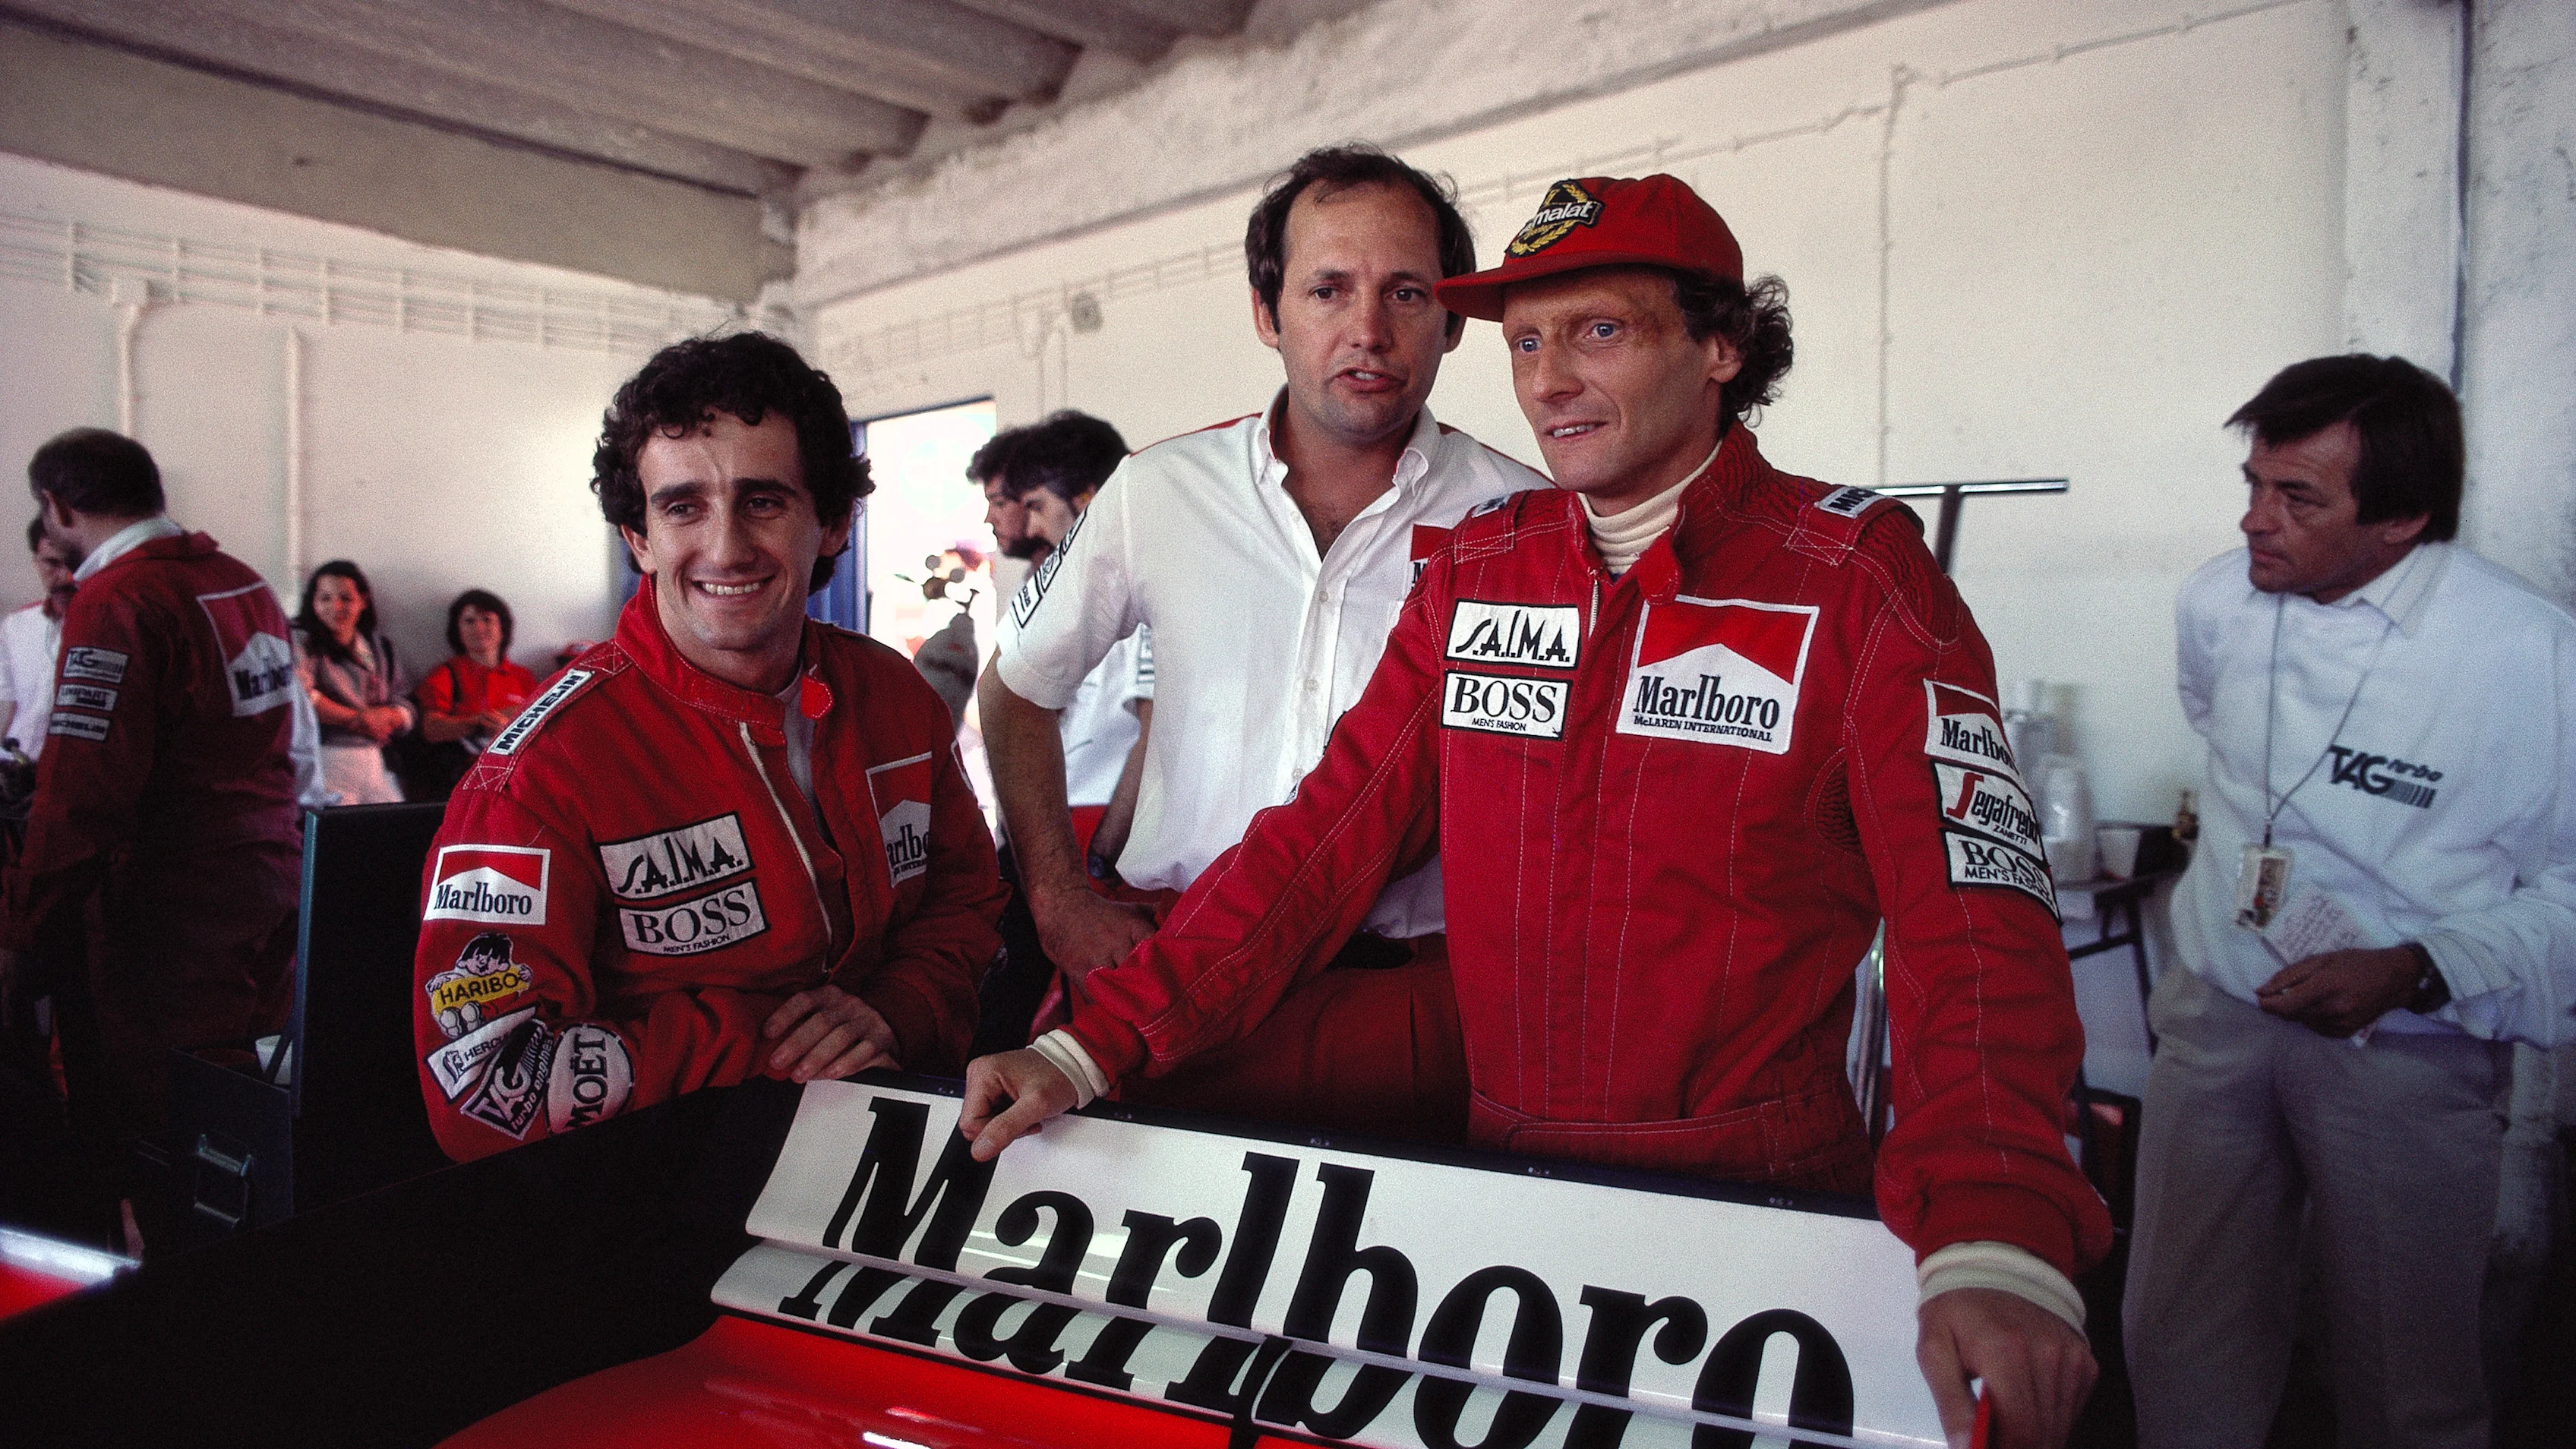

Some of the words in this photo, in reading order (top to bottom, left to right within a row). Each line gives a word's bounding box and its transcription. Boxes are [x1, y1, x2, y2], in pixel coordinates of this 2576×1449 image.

[1530, 200, 1593, 229] malat
[496, 675, 583, 750] MICHELIN
[1451, 676, 1557, 723] BOSS
[1633, 674, 1780, 729] Marlboro
[1472, 718, 1495, 728] MEN'S
[1496, 721, 1526, 731] FASHION
[1634, 715, 1682, 730] McLAREN
[1683, 721, 1773, 742] INTERNATIONAL
[2328, 744, 2389, 794] TAG
[1994, 825, 2028, 845] ZANETTI
[1965, 865, 2010, 882] MEN'S
[434, 882, 532, 915] Marlboro
[630, 890, 751, 944] BOSS
[663, 944, 691, 953] MEN'S
[693, 933, 731, 949] FASHION
[440, 973, 519, 1005] HARIBO
[463, 1035, 504, 1061] HERC
[533, 1034, 555, 1092] engines
[472, 1062, 532, 1122] TAG
[778, 1097, 1855, 1449] Marlboro
